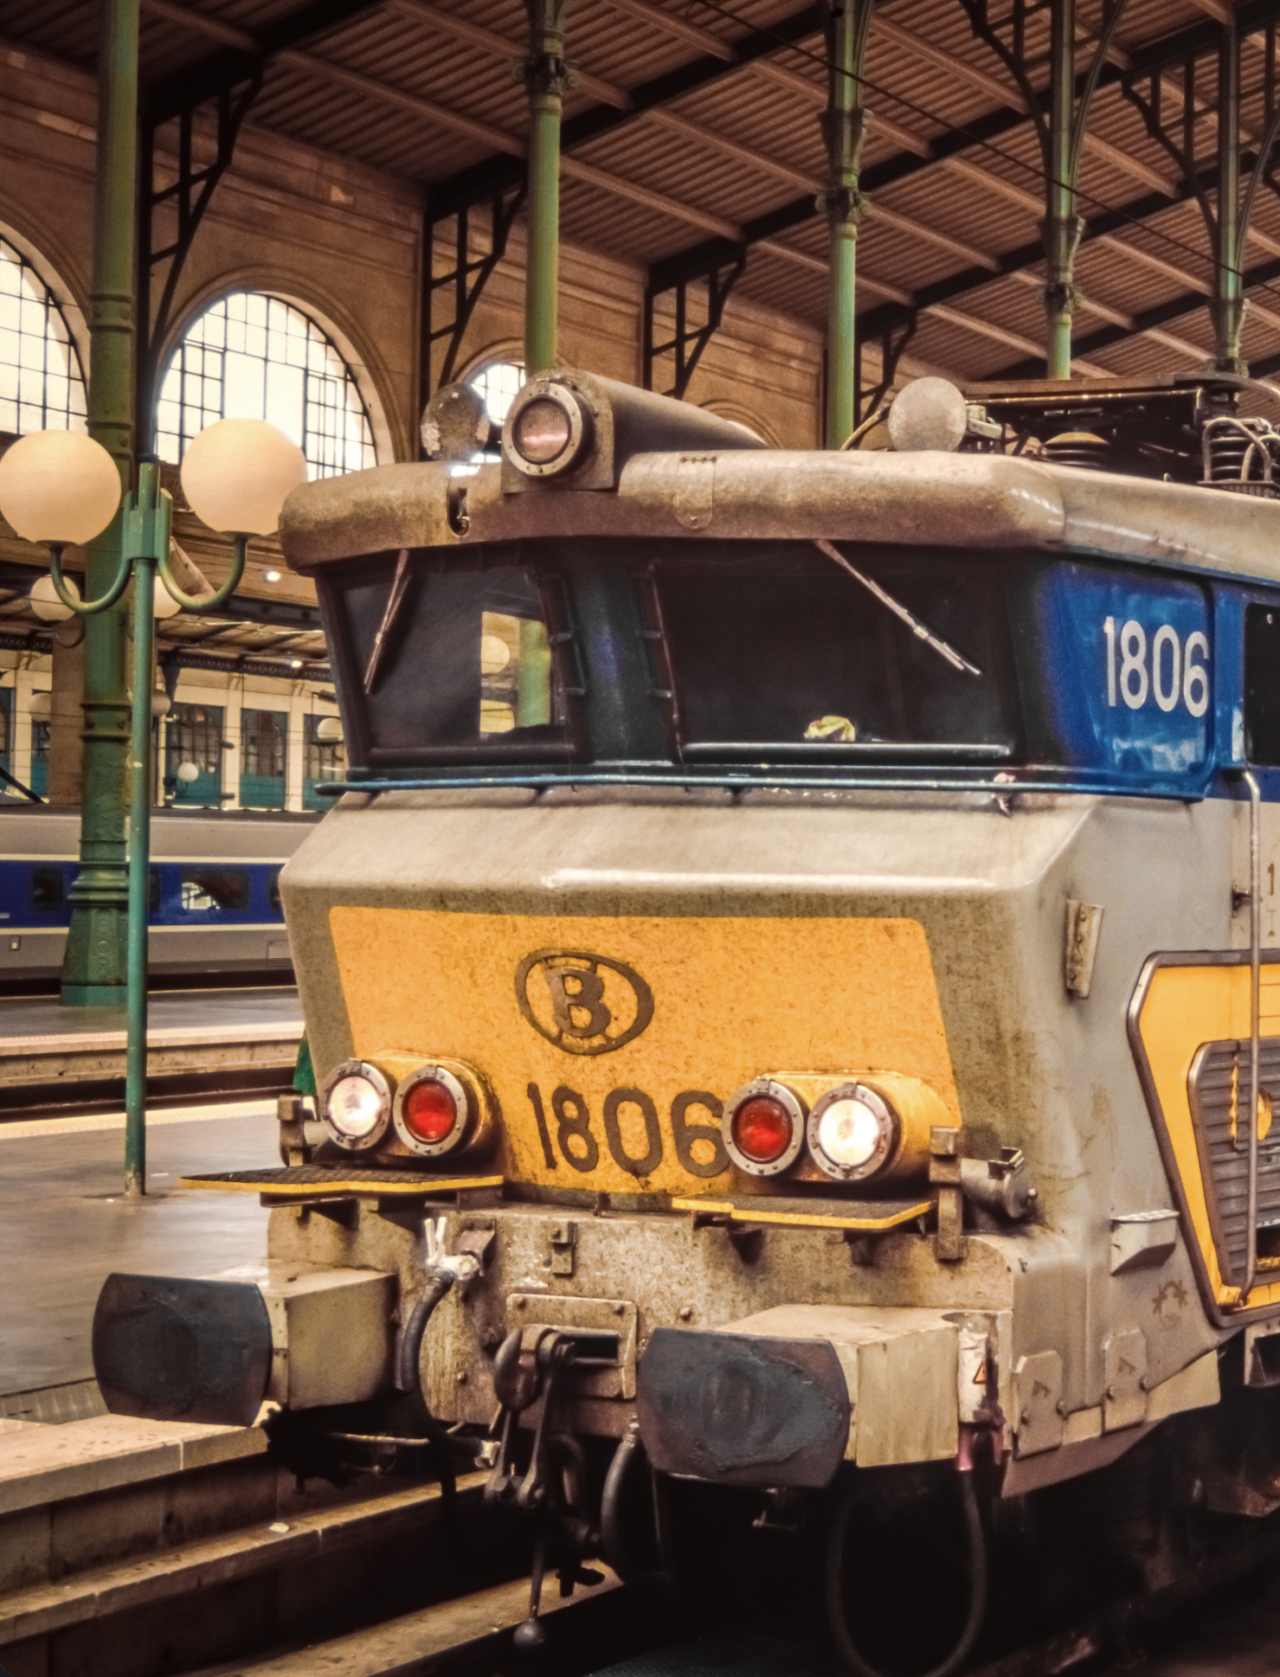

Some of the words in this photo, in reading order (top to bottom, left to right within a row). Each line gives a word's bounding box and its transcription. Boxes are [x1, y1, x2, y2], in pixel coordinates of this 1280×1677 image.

[1103, 615, 1210, 718] 1806
[543, 965, 612, 1039] B
[526, 1081, 731, 1179] 1806
